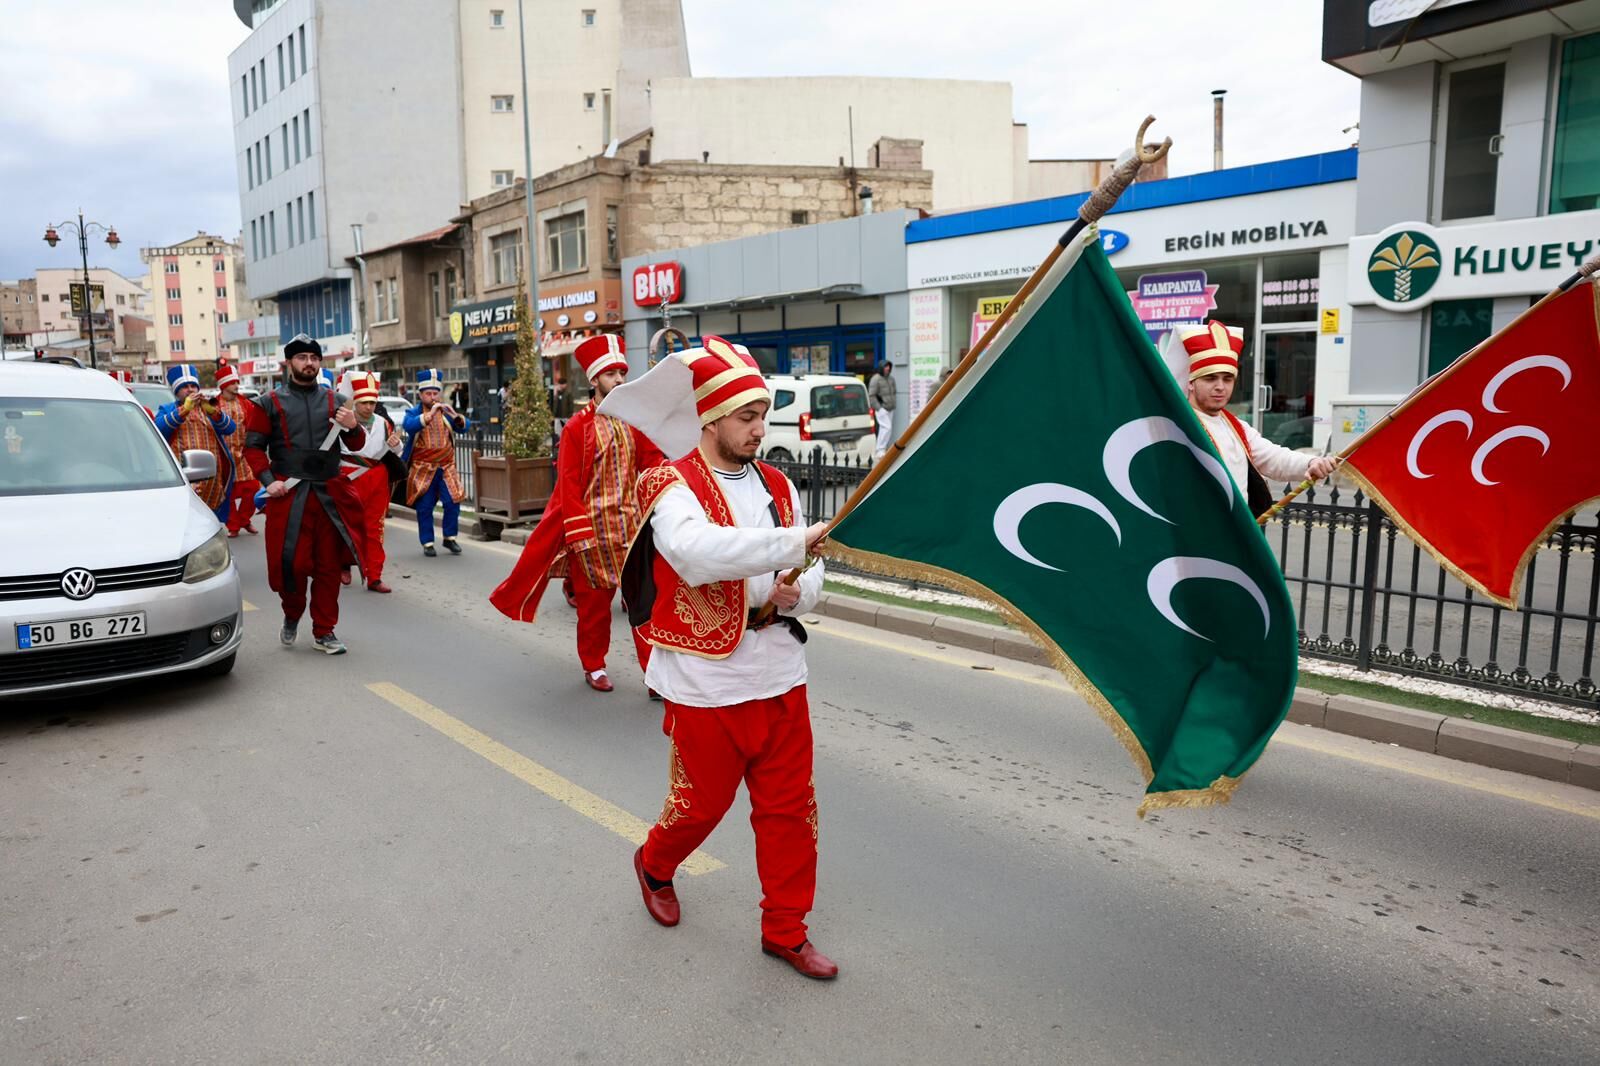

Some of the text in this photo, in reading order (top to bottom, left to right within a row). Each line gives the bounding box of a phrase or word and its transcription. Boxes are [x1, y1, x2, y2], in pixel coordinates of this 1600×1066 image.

[1165, 220, 1328, 252] ERGİN MOBİLYA
[1454, 239, 1600, 276] KUVEY
[635, 264, 675, 300] BİM
[951, 272, 982, 281] MODÜLER
[1143, 280, 1202, 296] KAMPANYA
[563, 290, 596, 308] LOKMASI
[1177, 306, 1192, 318] AY
[464, 300, 517, 326] NEW STİ
[31, 625, 55, 644] 50
[70, 622, 93, 640] BG
[107, 616, 141, 636] 272
